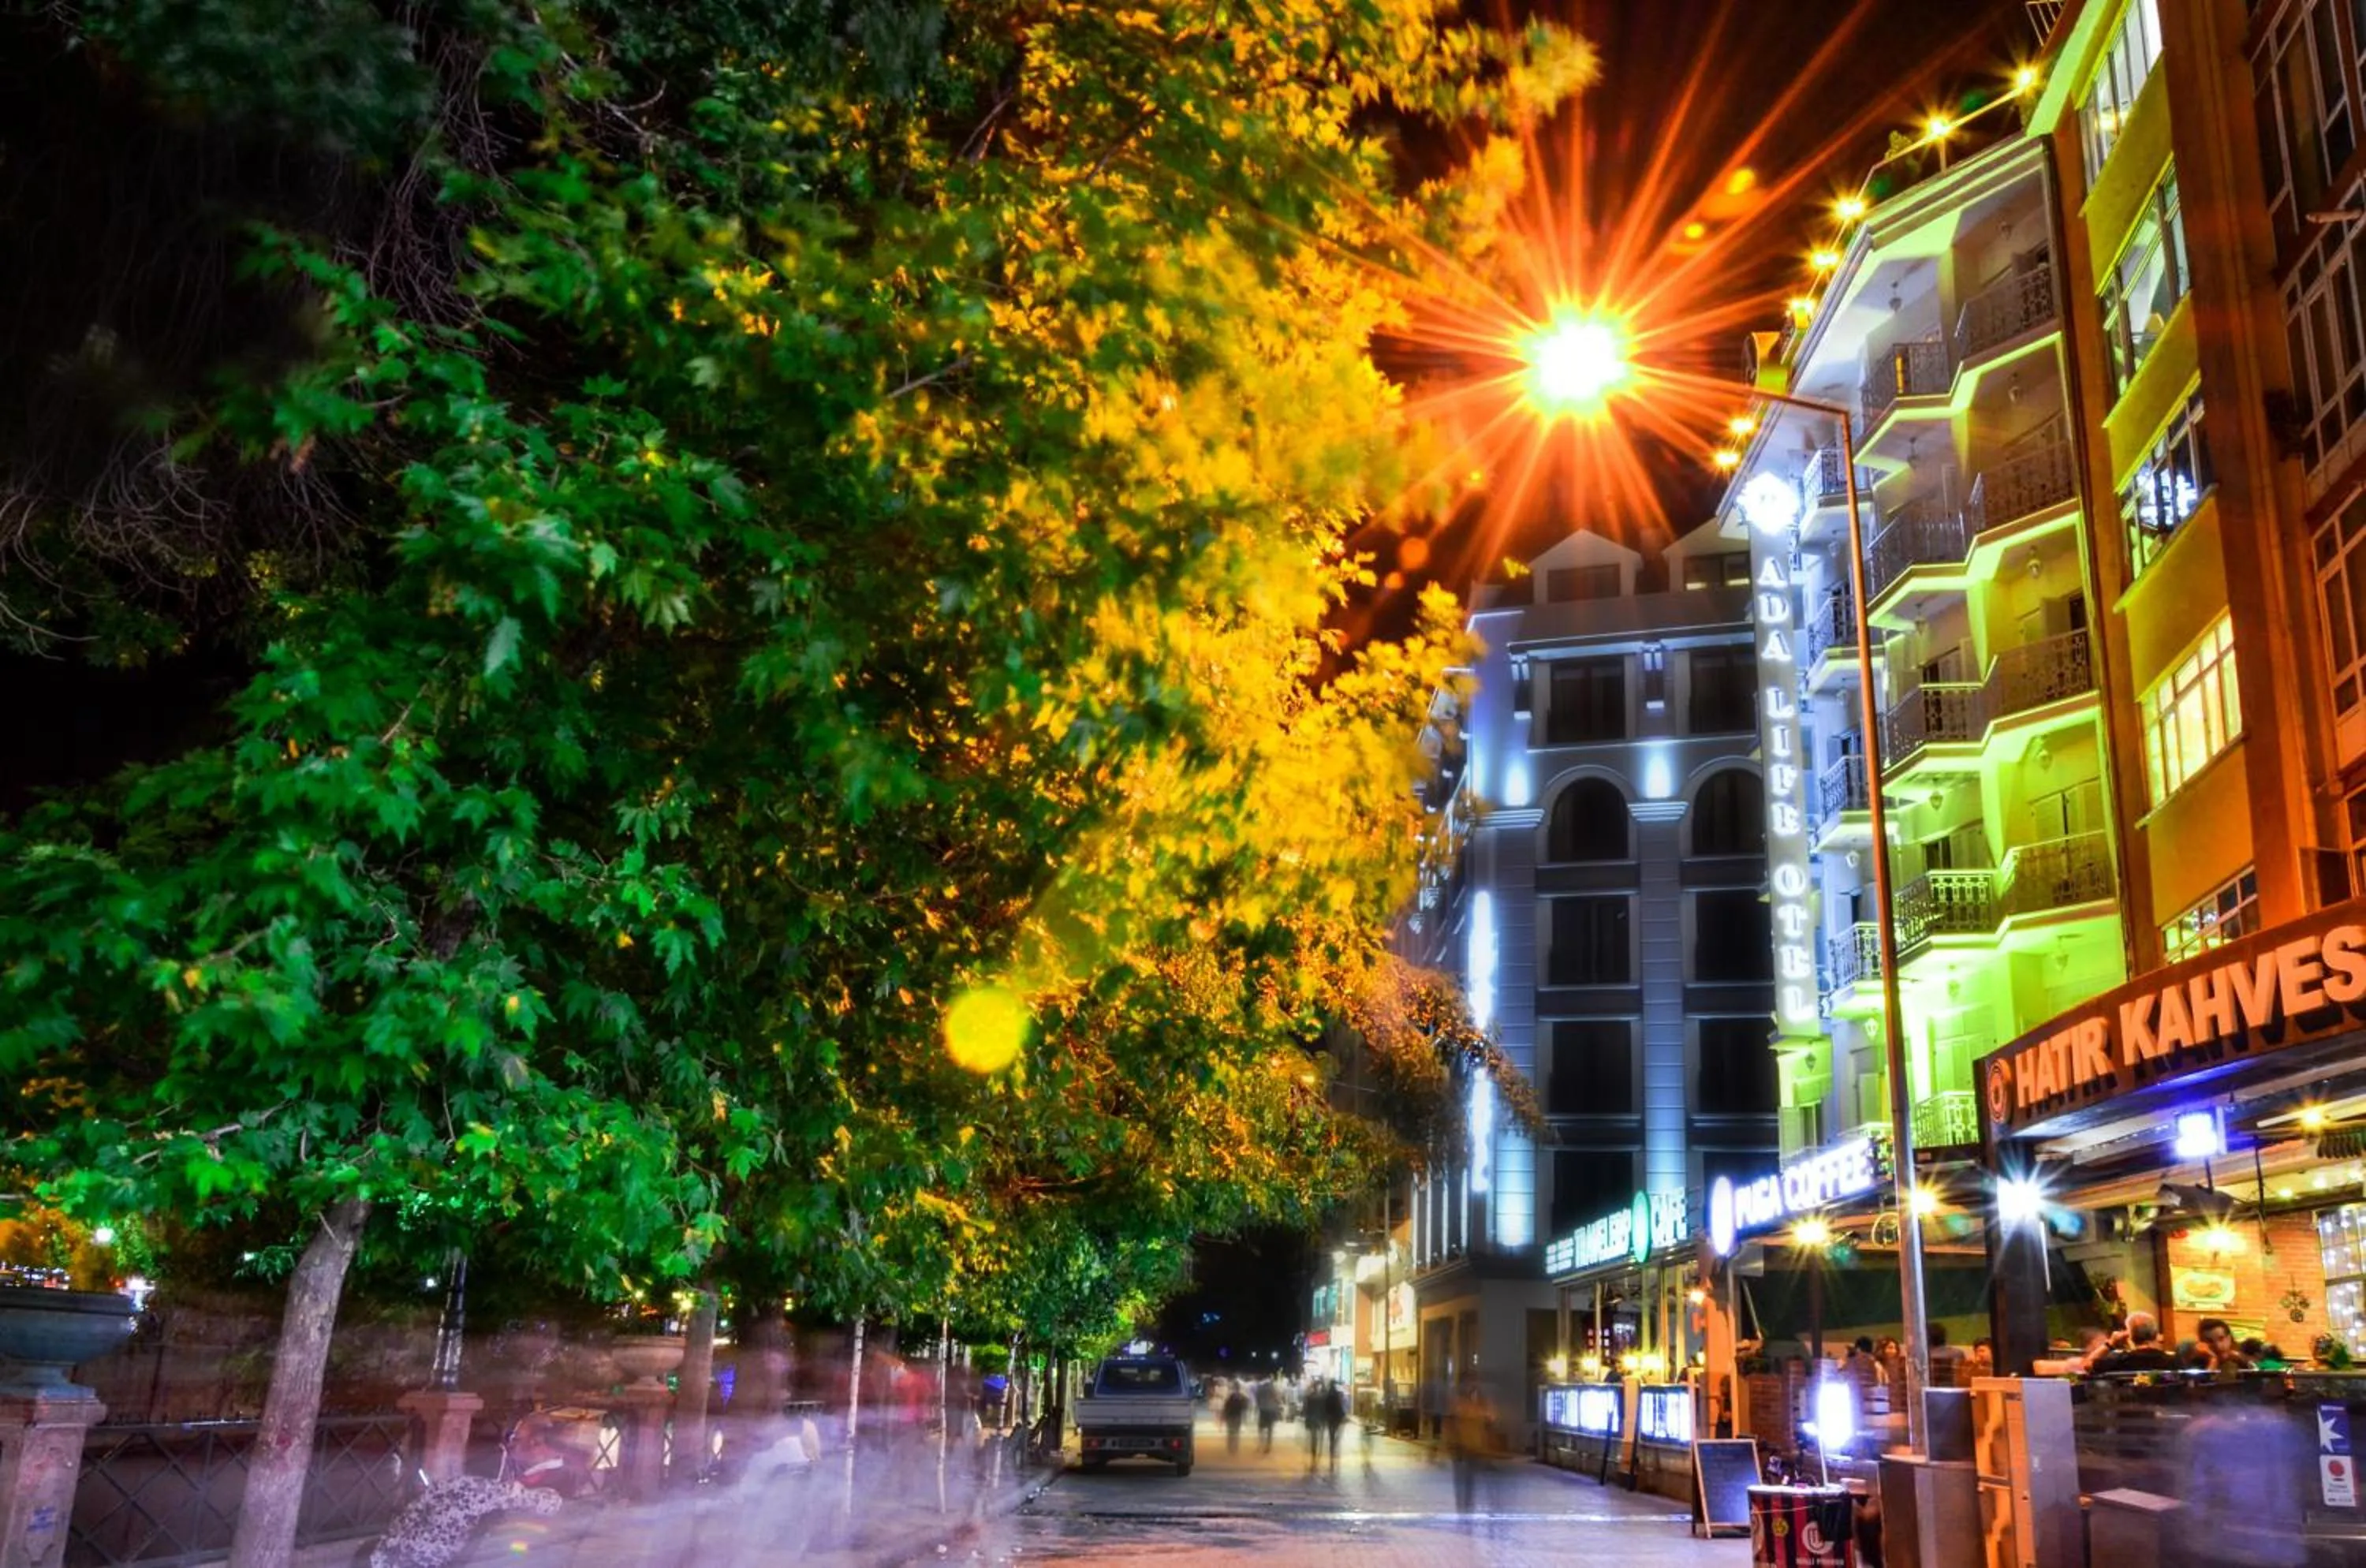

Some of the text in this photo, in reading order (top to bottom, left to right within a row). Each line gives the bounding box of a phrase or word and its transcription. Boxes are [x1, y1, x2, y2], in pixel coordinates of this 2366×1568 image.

[1756, 555, 1815, 1022] ADA LIFE OTEL
[2014, 924, 2366, 1108] HATIR KAHVES
[1782, 1137, 1871, 1211] COFFEE
